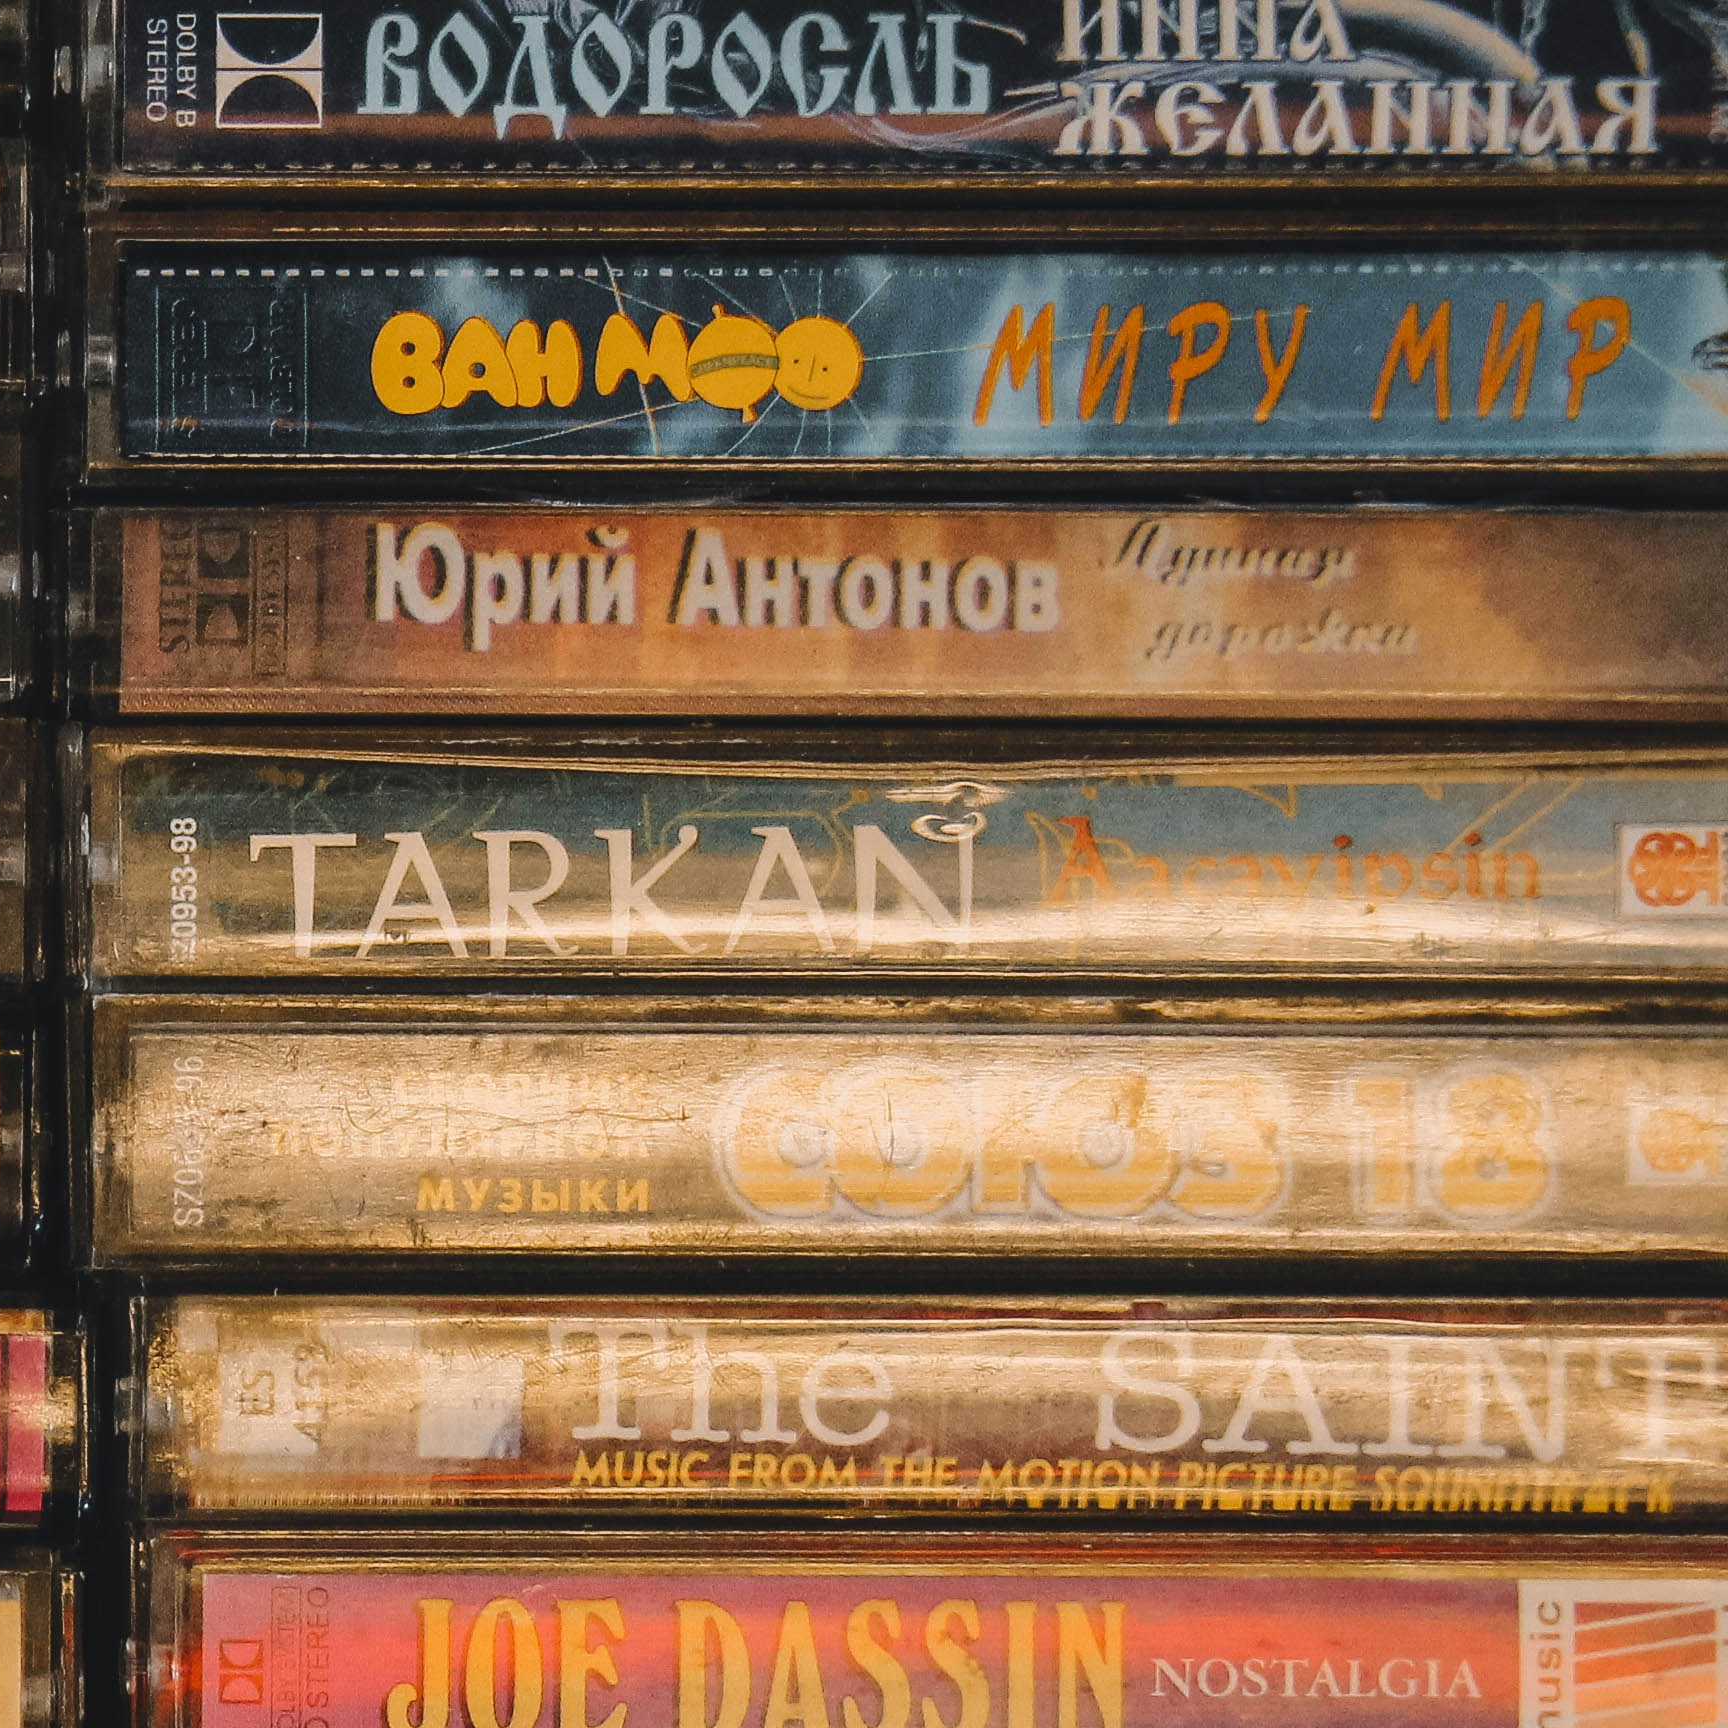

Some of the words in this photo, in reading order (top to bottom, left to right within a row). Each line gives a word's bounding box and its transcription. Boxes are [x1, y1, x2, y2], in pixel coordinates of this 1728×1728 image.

[147, 19, 167, 122] STEREO
[176, 13, 197, 104] DOLBY
[357, 11, 991, 141] ВОДОРОСЛЬ
[1056, 0, 1357, 62] ИННА
[176, 112, 197, 128] B
[1055, 77, 1660, 158] ЖЕЛАННАЯ
[974, 300, 1312, 427] МИРУ
[1371, 295, 1632, 424] МИР
[371, 523, 637, 652] Юрий
[669, 527, 1060, 633] Антонов
[249, 812, 986, 960] TARKAN
[416, 1177, 652, 1213] МУЗЫКИ
[304, 1585, 329, 1708] STEREO
[1150, 1656, 1483, 1700] NOSTALGIA
